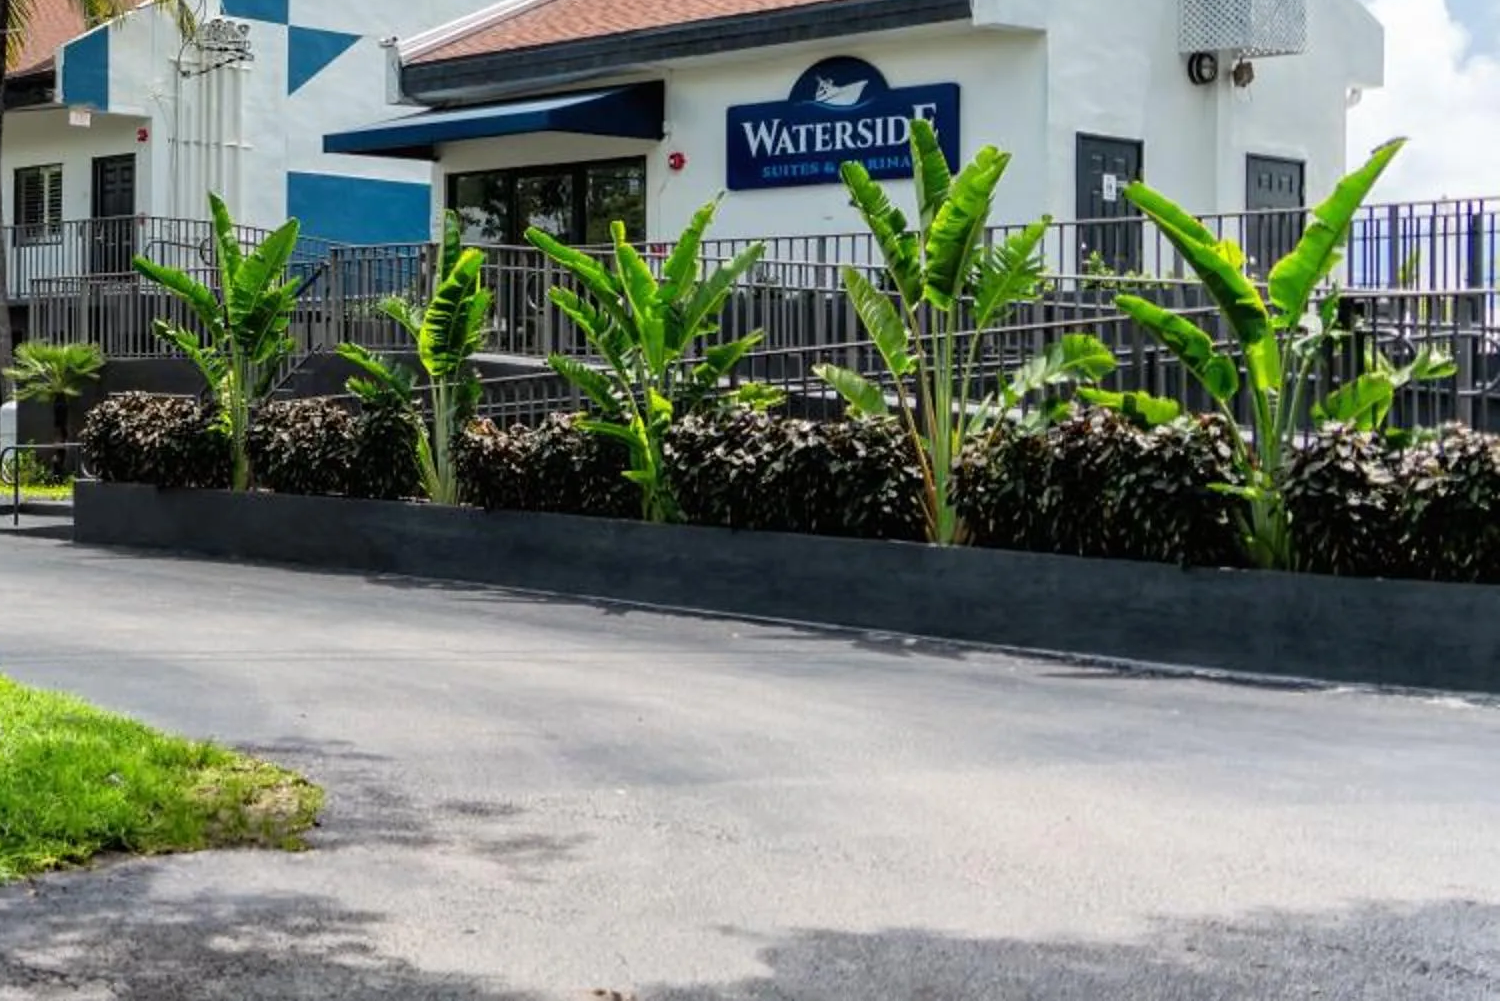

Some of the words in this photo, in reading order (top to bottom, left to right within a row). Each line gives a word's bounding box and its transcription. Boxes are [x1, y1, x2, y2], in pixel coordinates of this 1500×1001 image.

[762, 161, 819, 178] SUITES
[824, 161, 836, 174] &
[848, 155, 911, 171] RINA
